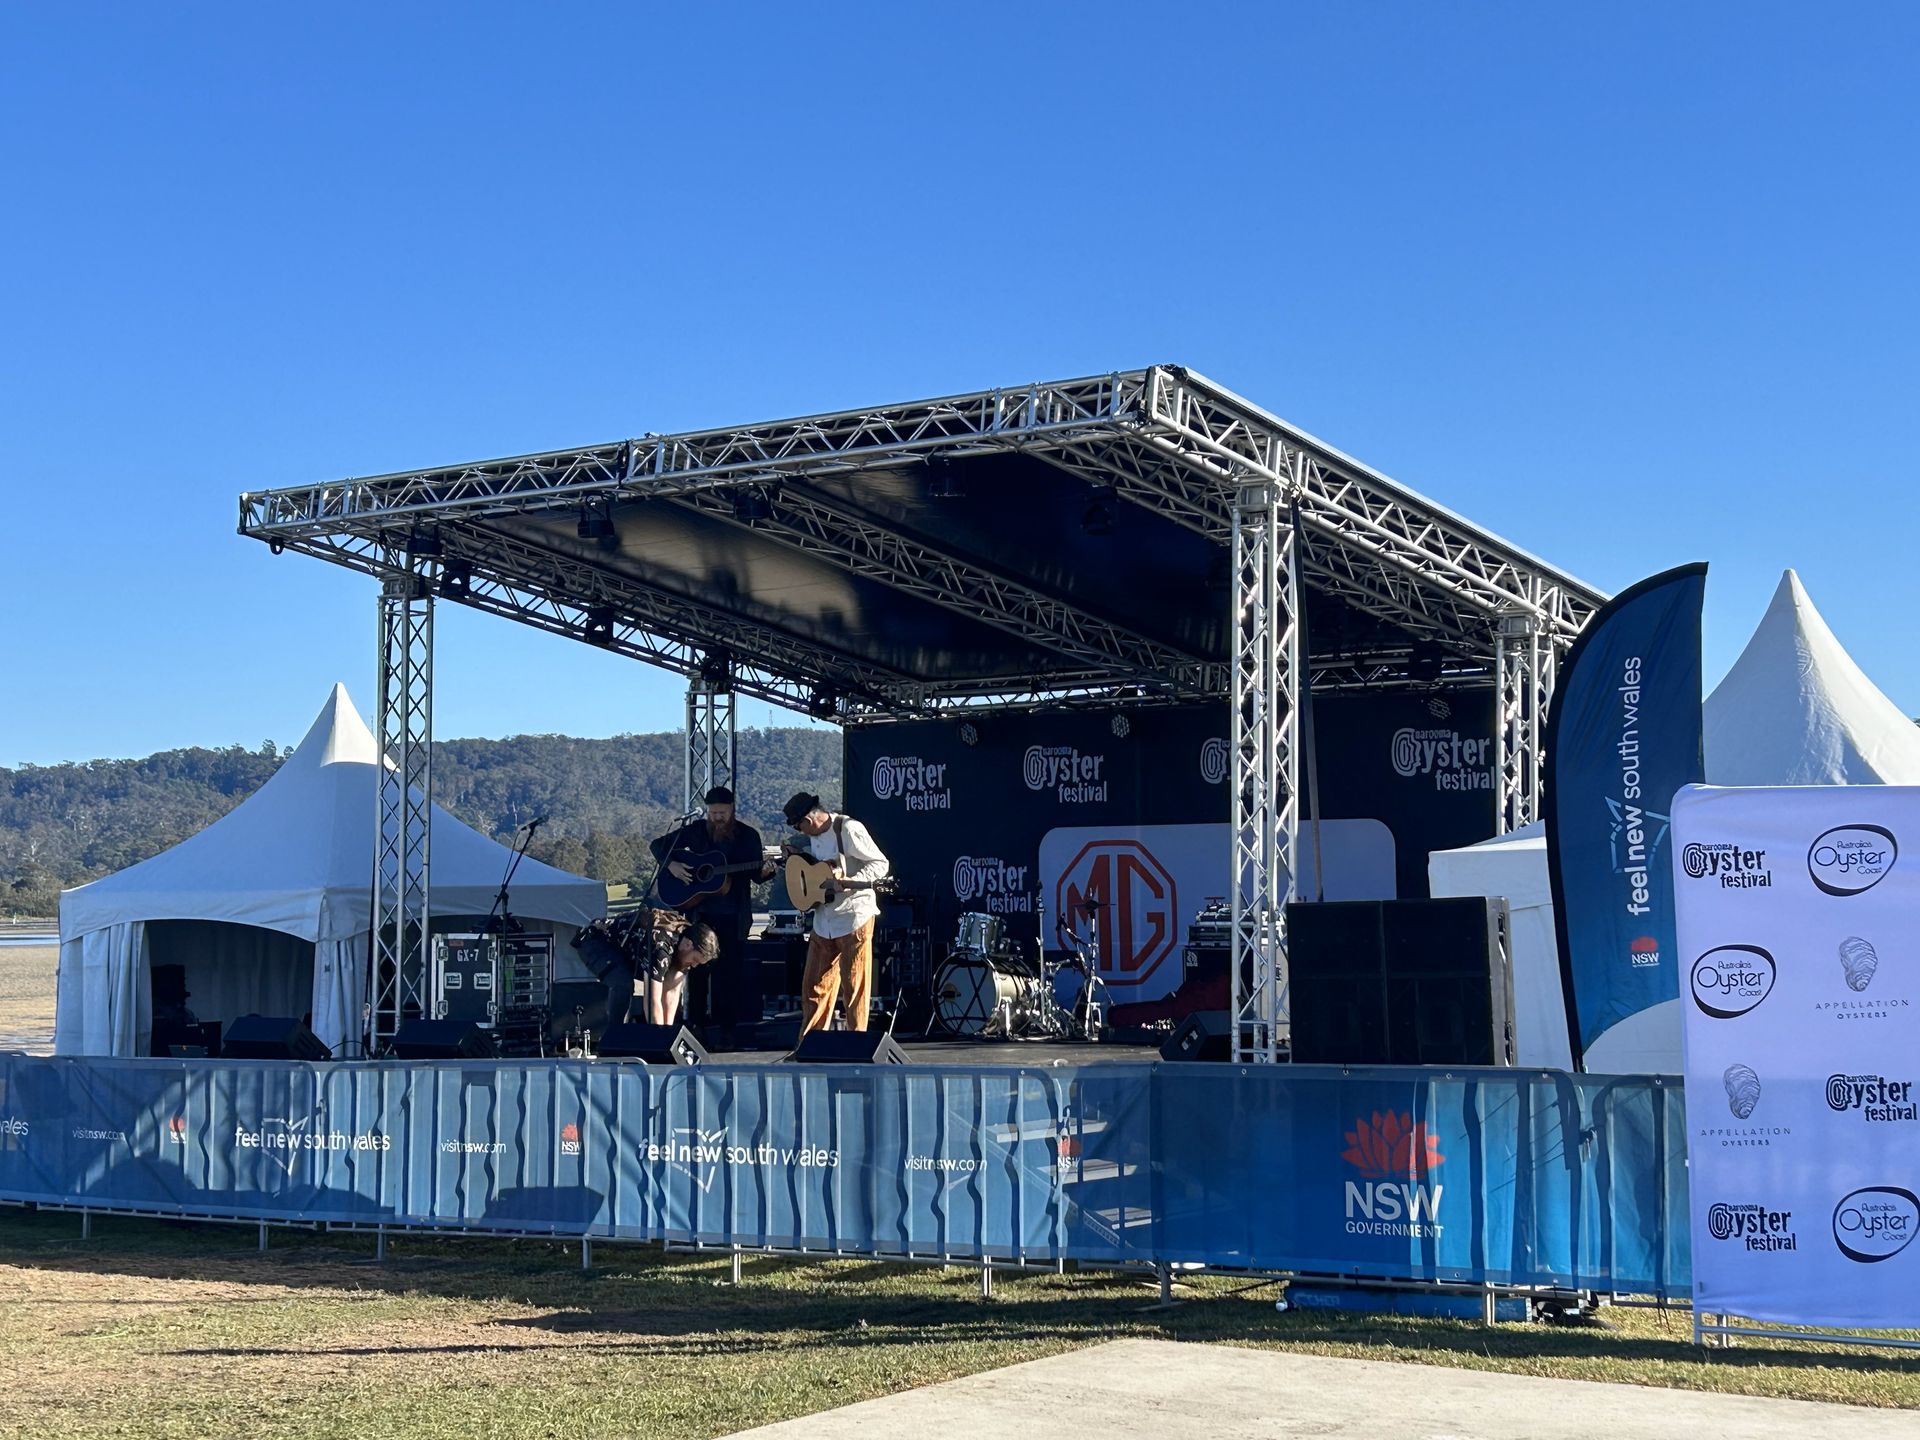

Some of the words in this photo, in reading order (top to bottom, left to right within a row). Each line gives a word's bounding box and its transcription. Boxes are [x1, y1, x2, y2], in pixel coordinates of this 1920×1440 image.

[1618, 656, 1642, 727] wales
[1391, 728, 1490, 777] Oyster
[1617, 730, 1641, 799] south
[873, 756, 946, 799] Oyster
[1023, 745, 1104, 790] Oyster
[1434, 767, 1495, 791] festival
[905, 788, 950, 811] festival
[1058, 781, 1107, 803] festival
[1625, 805, 1646, 860] new
[1683, 843, 1766, 878] Oyster
[1814, 846, 1886, 873] Oyster
[953, 856, 1027, 902] Oyster
[1624, 866, 1650, 915] feel
[1720, 871, 1772, 888] festival
[986, 892, 1031, 914] festival
[1066, 854, 1166, 972] MG
[1631, 952, 1660, 964] NSW
[1697, 966, 1765, 995] Oyster
[1815, 999, 1909, 1010] APPELLATION
[1826, 1074, 1911, 1111] Oyster
[1865, 1103, 1918, 1121] festival
[235, 1127, 264, 1147] feel
[268, 1132, 301, 1149] new
[304, 1130, 346, 1149] south
[348, 1130, 391, 1150] wales
[441, 1139, 507, 1153] visitnsw.com
[1701, 1127, 1791, 1136] APPELLATION
[638, 1138, 675, 1161] feel
[680, 1146, 721, 1163] new
[725, 1142, 777, 1165] south
[782, 1144, 839, 1167] wales
[904, 1155, 988, 1171] visitnsw.com
[1345, 1181, 1443, 1221] NSW
[1345, 1220, 1444, 1238] GOVERNMENT
[1708, 1203, 1791, 1240] Oyster
[1839, 1208, 1910, 1238] Oyster
[1745, 1233, 1796, 1251] festival
